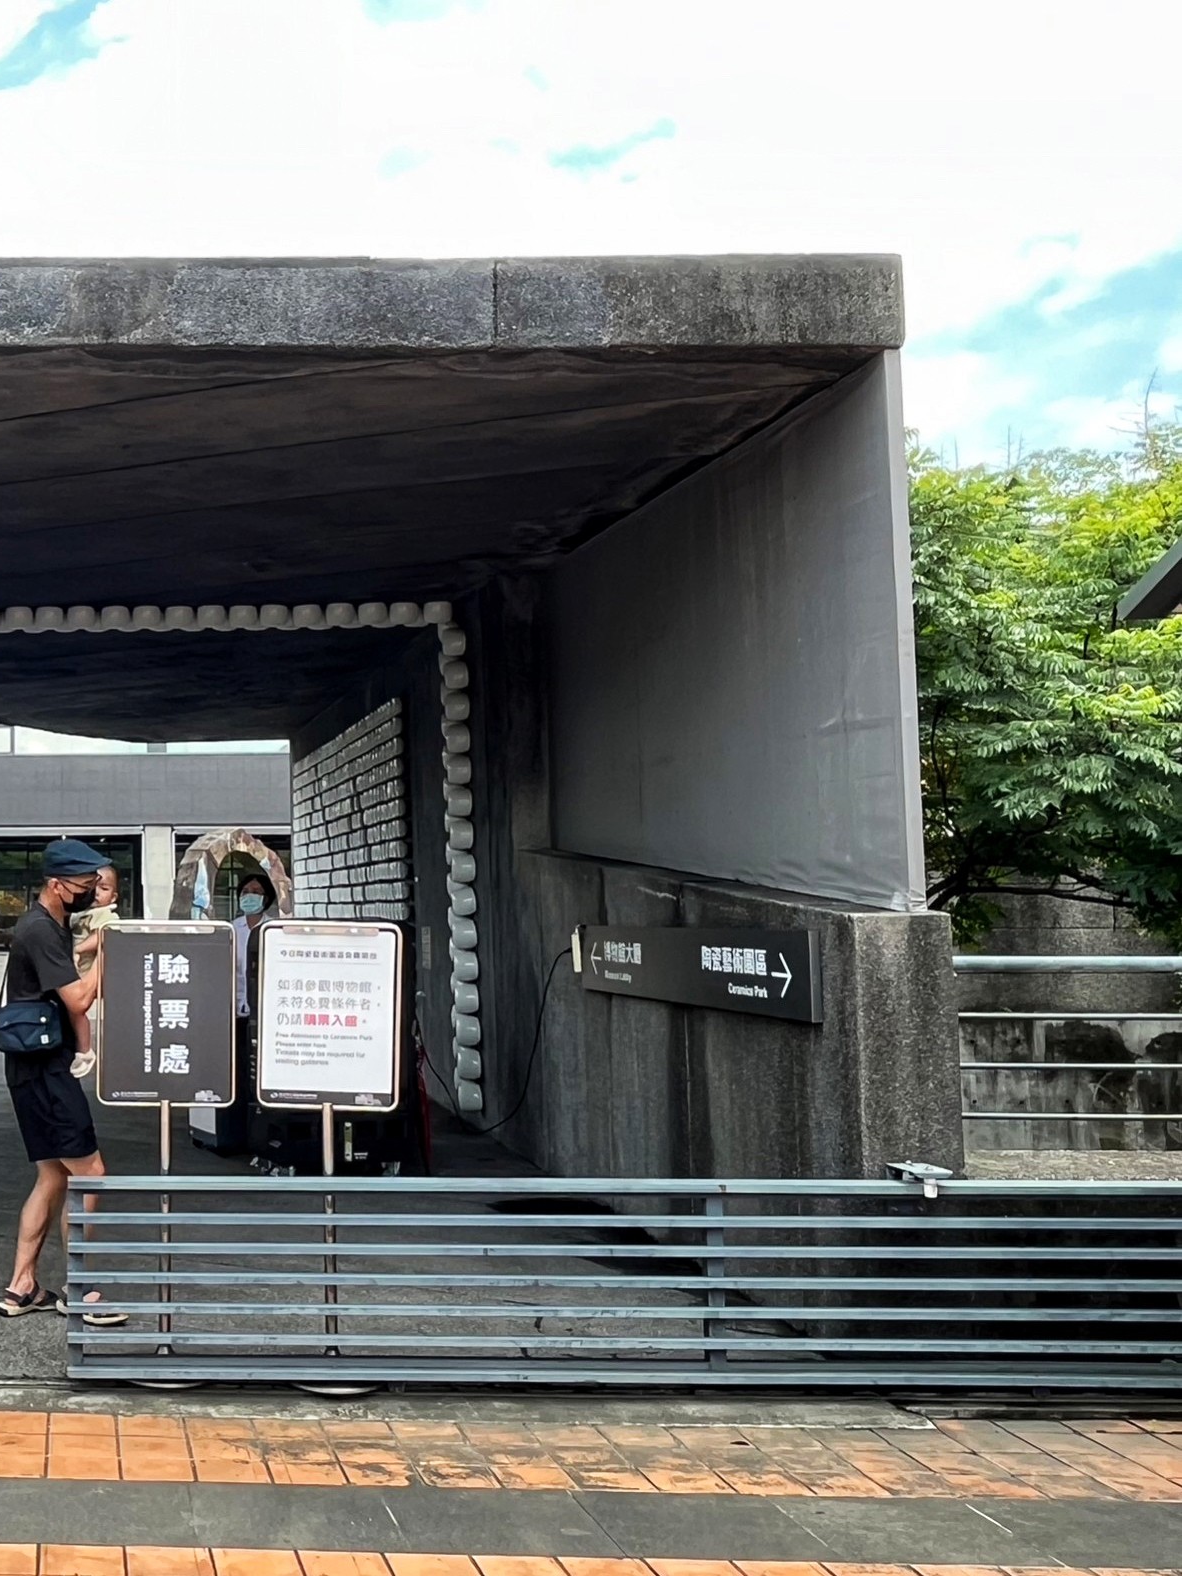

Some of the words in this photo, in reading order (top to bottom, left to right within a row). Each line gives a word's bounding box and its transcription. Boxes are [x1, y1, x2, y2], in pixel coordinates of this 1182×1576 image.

[143, 952, 154, 988] Ticket
[701, 945, 767, 976] 陶瓷藝術園區
[158, 954, 189, 1074] 驗票處
